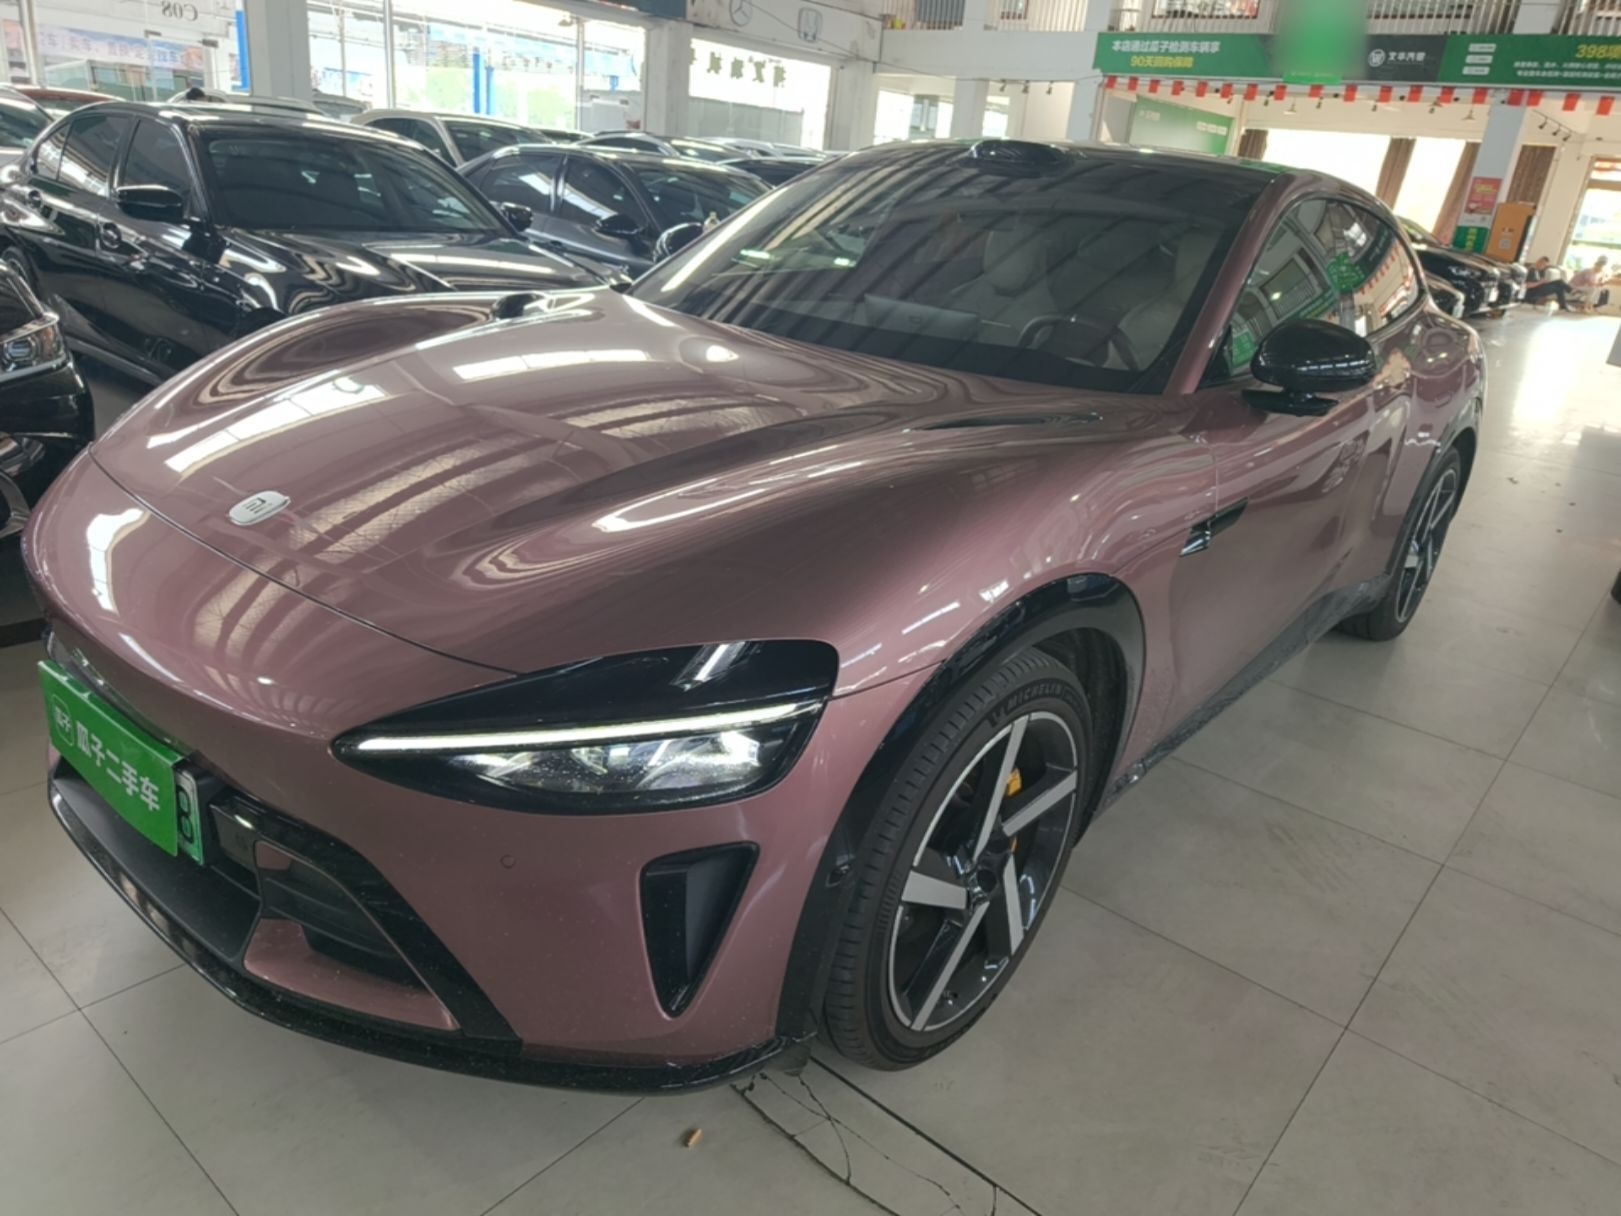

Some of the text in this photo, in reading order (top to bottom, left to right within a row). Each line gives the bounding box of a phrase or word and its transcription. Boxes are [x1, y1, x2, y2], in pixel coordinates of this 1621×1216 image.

[1008, 682, 1061, 709] MICHELIN
[76, 720, 160, 811] 瓜子二手车
